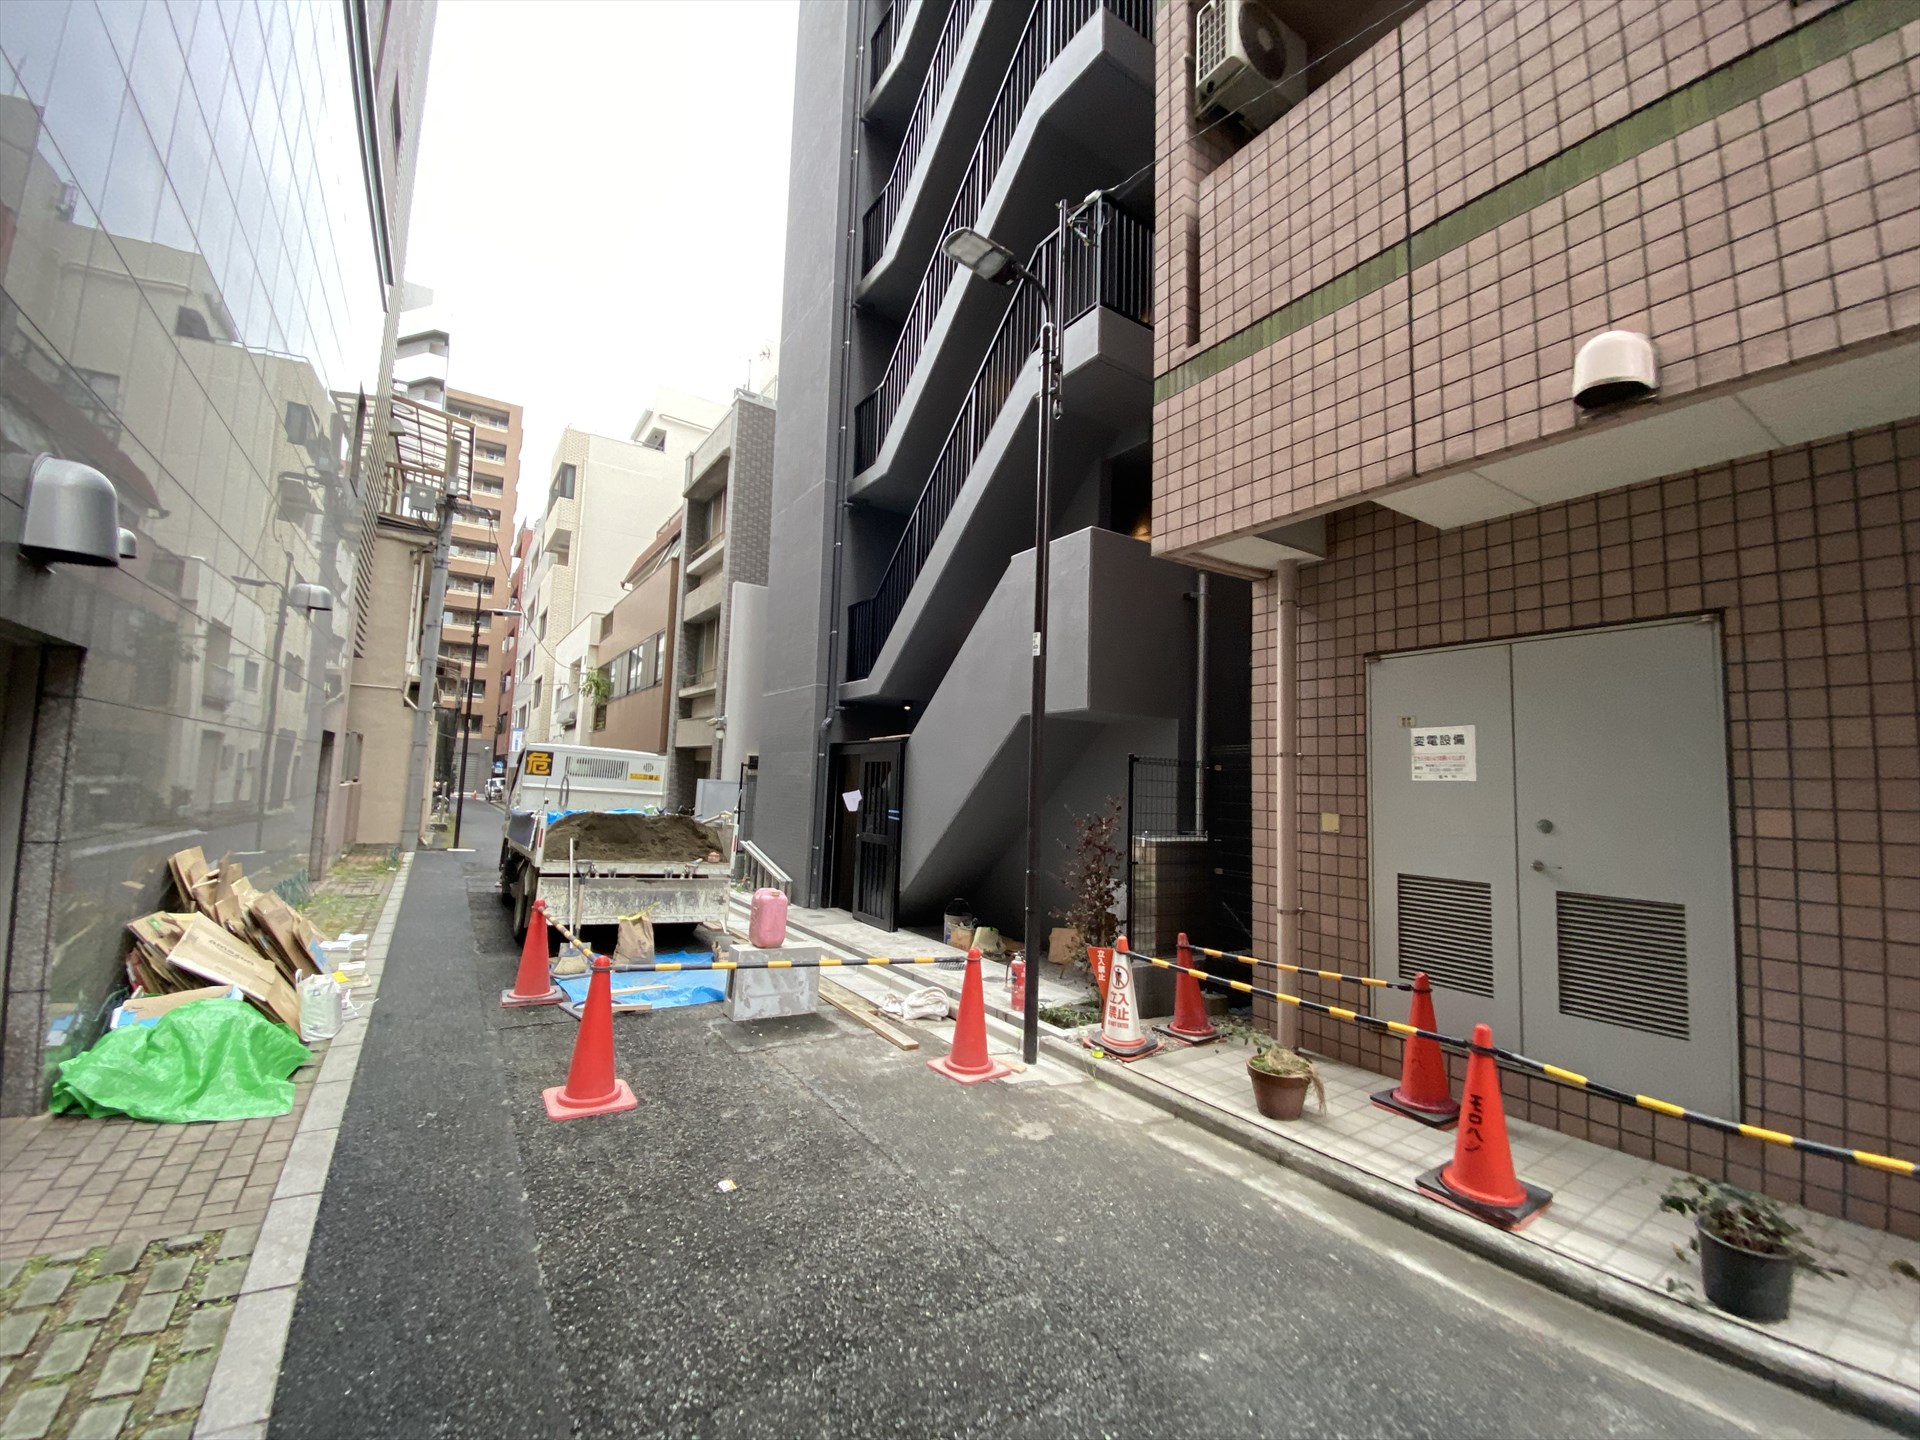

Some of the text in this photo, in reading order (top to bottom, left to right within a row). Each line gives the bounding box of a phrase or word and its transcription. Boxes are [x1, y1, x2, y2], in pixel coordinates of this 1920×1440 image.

[1413, 734, 1465, 747] 変電設備
[526, 752, 551, 775] 危
[1097, 950, 1106, 982] 立入禁止
